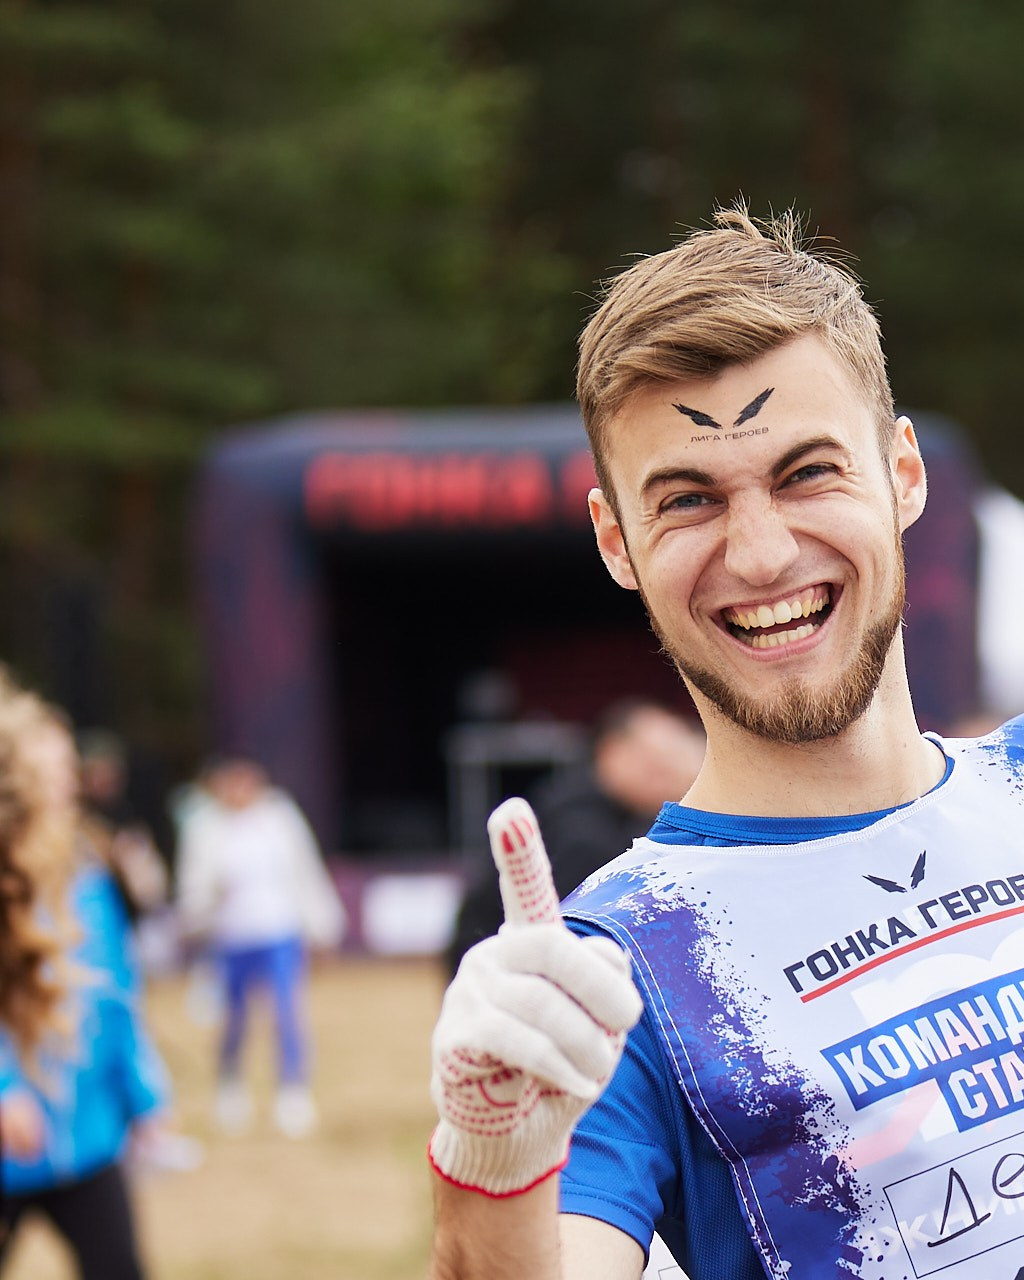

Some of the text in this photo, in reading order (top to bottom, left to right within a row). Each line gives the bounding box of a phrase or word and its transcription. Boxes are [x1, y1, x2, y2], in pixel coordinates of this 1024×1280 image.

[690, 427, 769, 443] ЛИГА ГЕРОЕВ
[783, 916, 918, 994] ГОНКА
